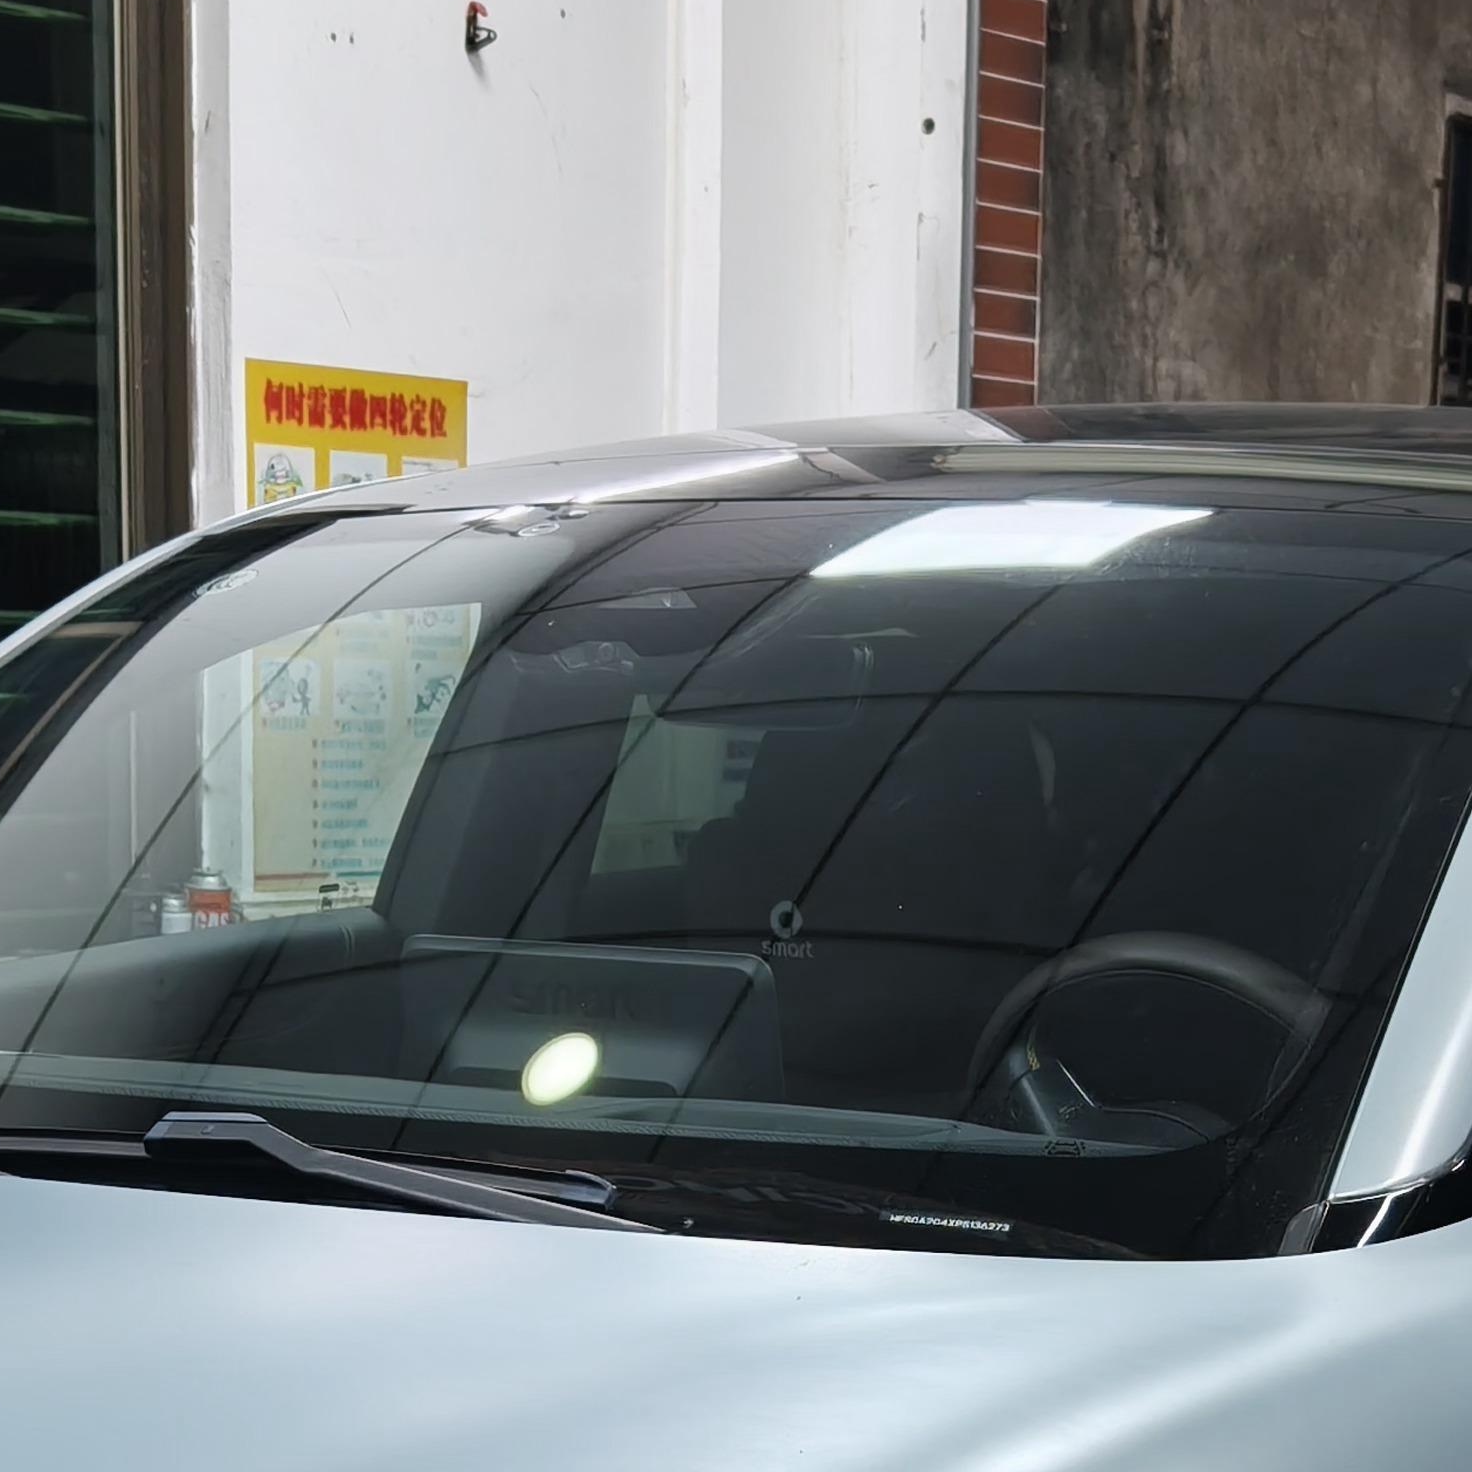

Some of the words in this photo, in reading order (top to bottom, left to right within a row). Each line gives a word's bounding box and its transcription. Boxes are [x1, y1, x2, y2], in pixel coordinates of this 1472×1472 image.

[264, 378, 448, 438] 何时需要做四轮定位
[761, 939, 816, 959] smart
